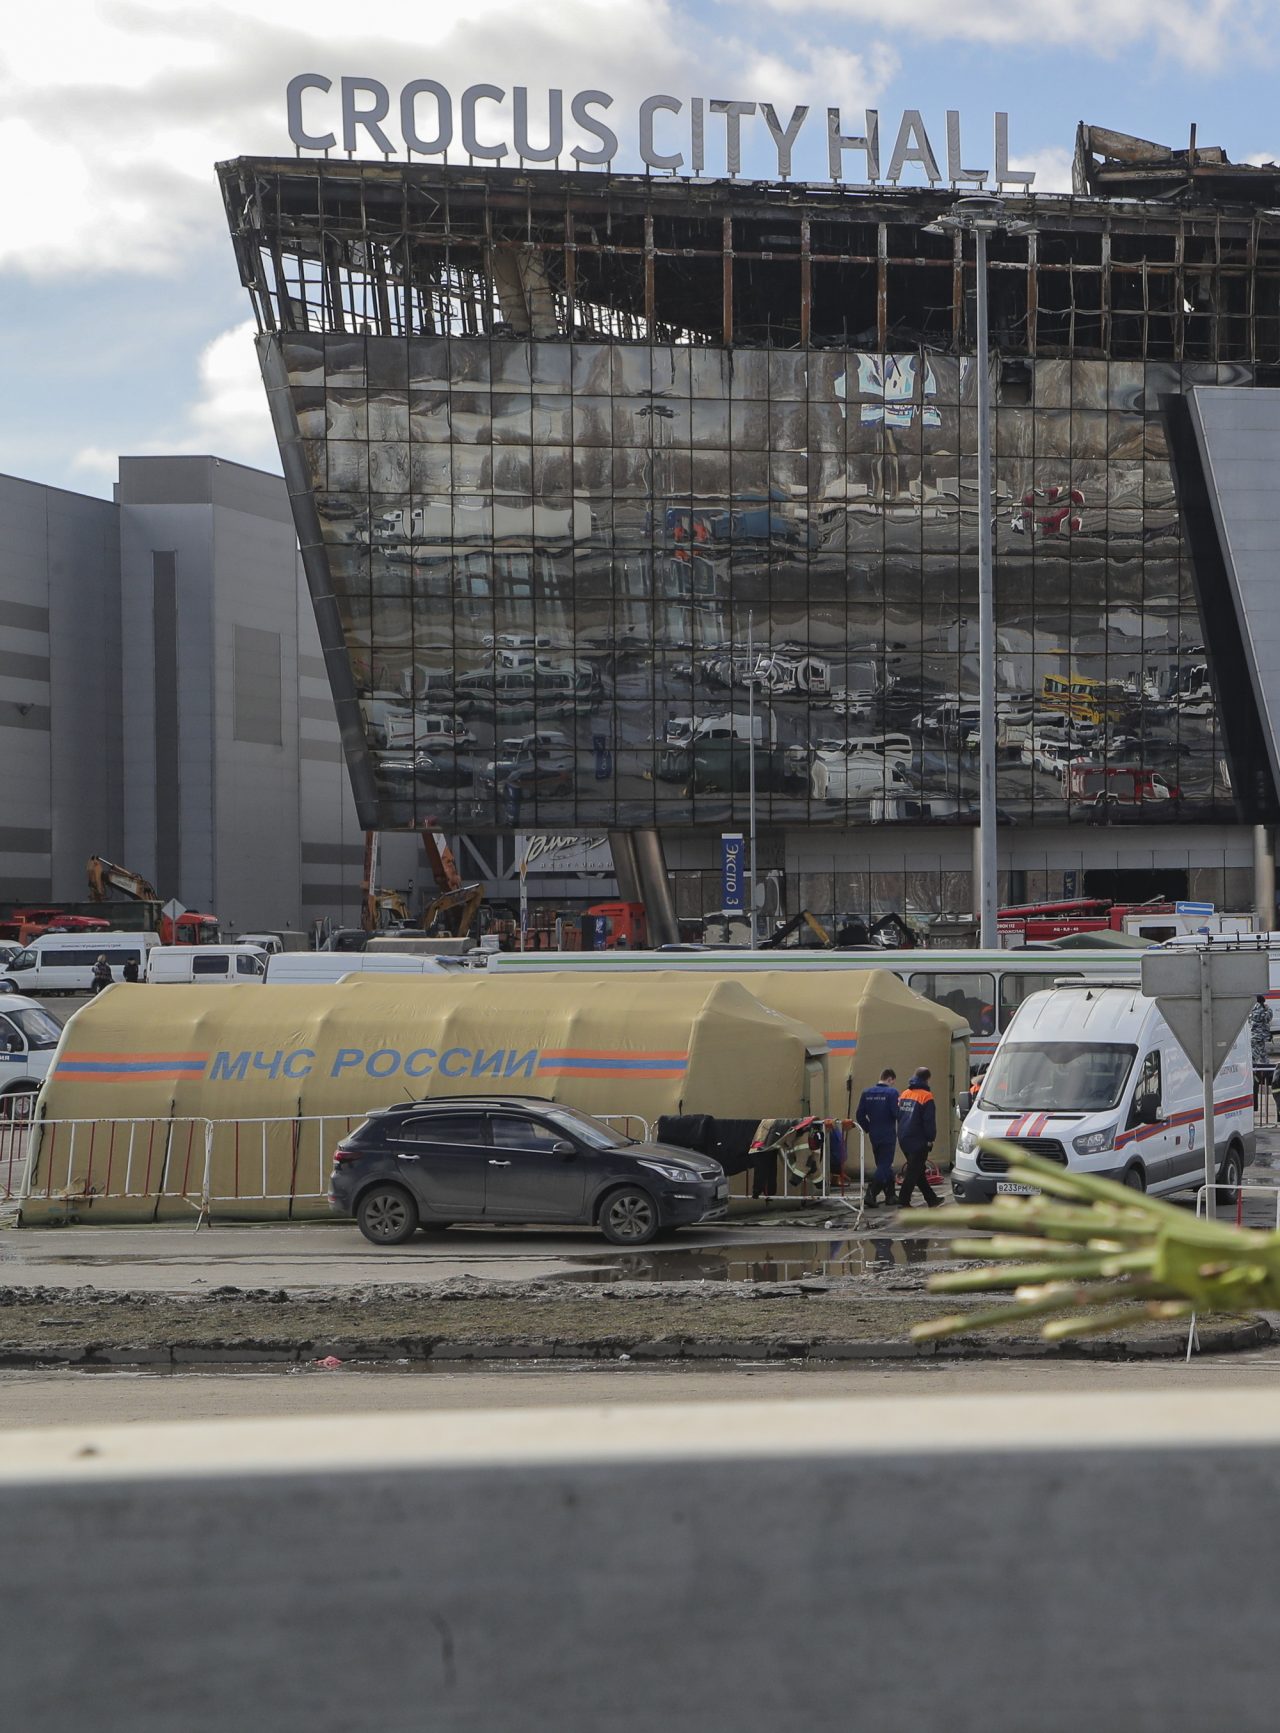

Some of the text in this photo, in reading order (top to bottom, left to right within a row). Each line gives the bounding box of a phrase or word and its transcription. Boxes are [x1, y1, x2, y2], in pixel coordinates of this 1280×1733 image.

[286, 73, 1036, 185] CROCUS CITY HALL
[726, 844, 739, 905] ЭКСПО 3
[209, 1048, 539, 1081] МЧС РОССИИ
[998, 1183, 1040, 1192] В233РМ
